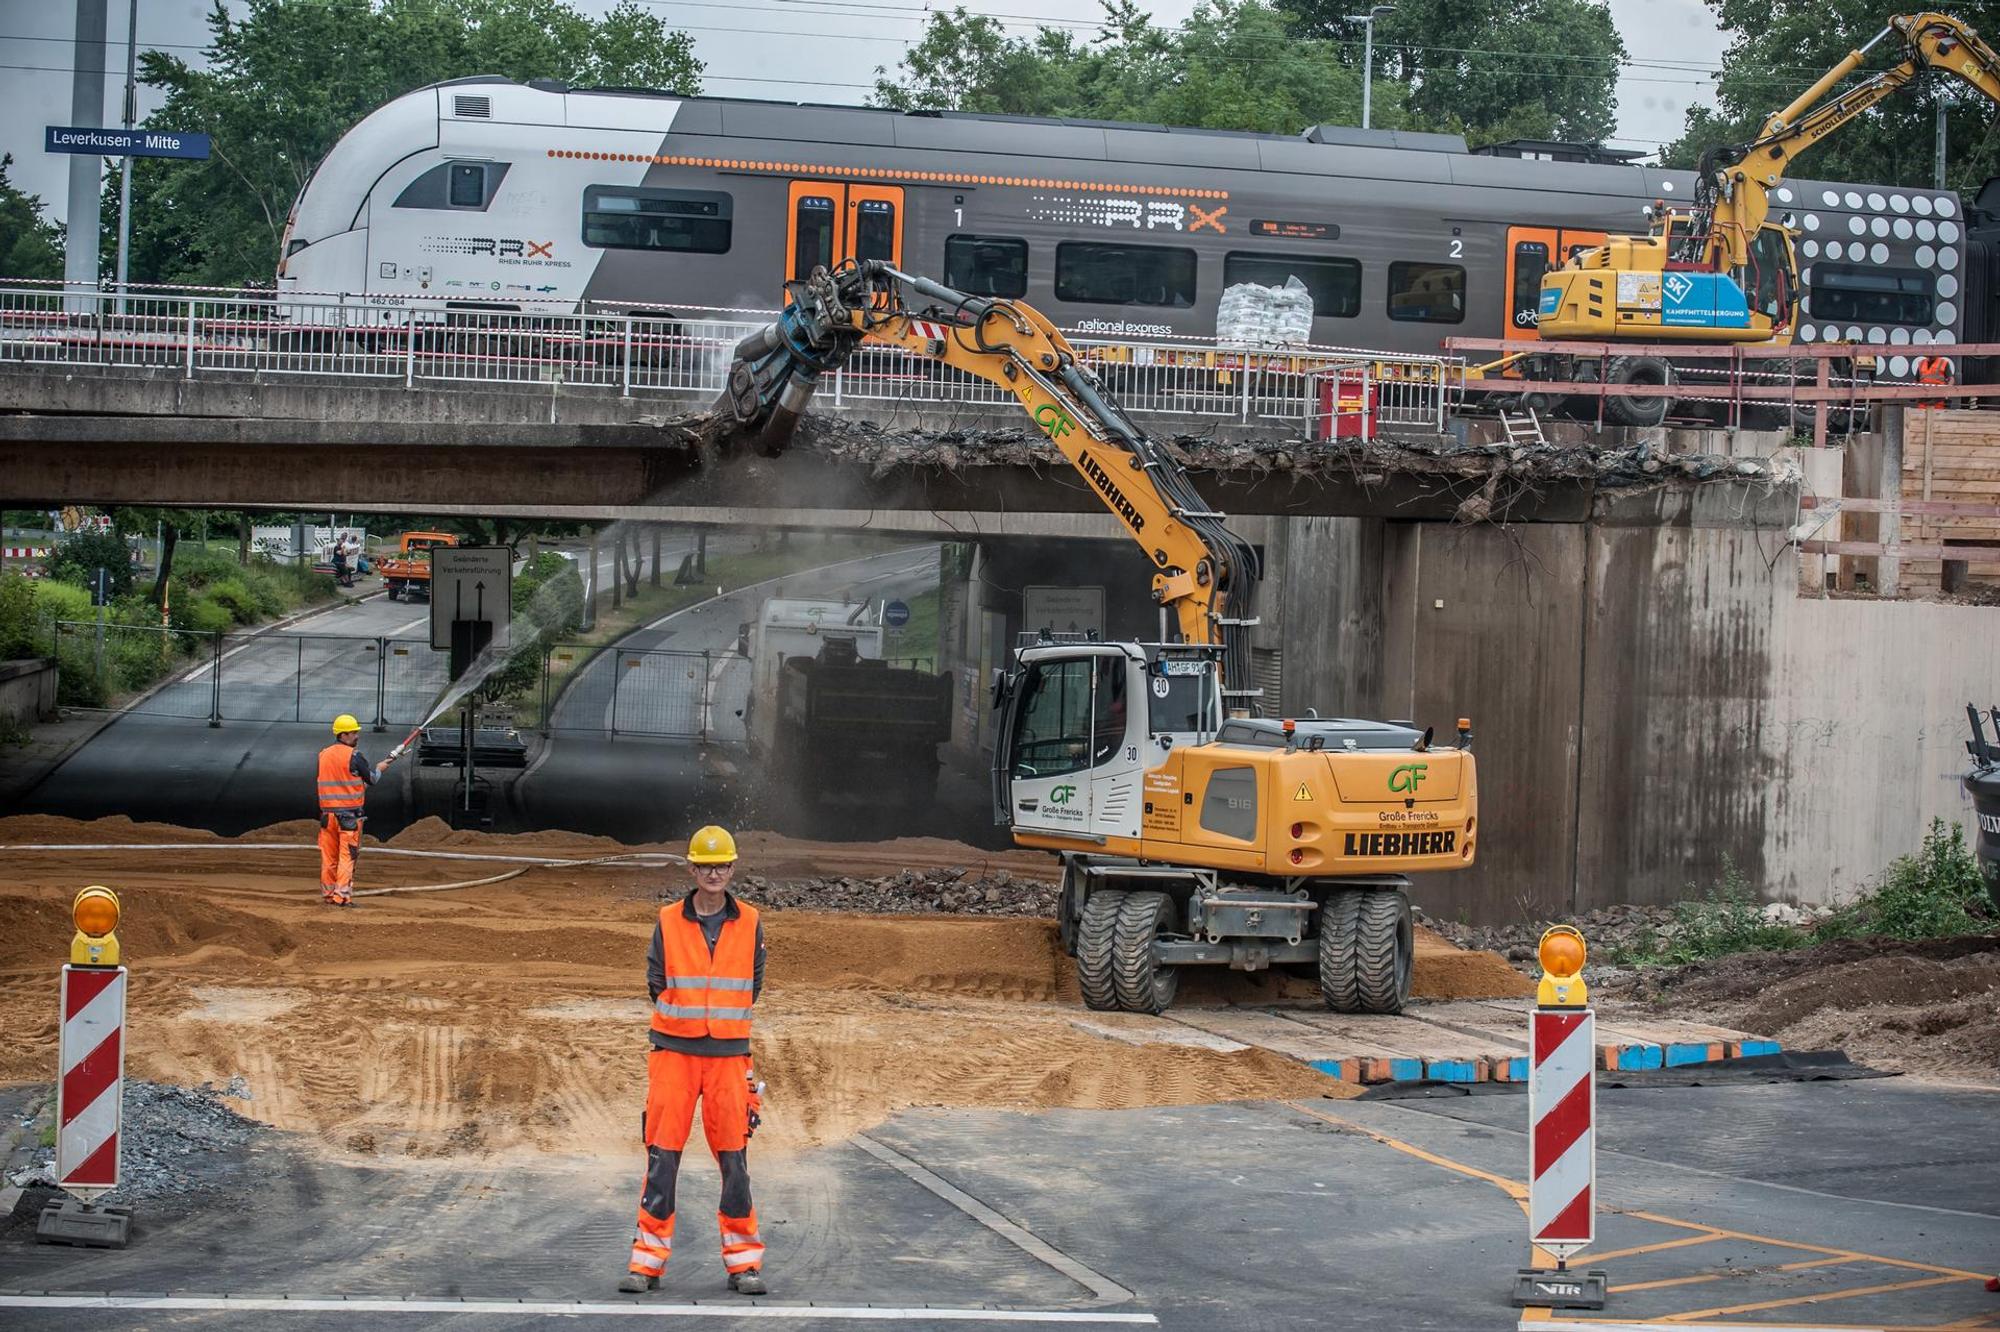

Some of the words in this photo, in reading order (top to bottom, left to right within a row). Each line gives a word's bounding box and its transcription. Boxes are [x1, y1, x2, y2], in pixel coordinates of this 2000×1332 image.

[53, 130, 131, 147] Leverkusen
[145, 135, 180, 150] Mitte
[954, 208, 963, 227] 1
[1449, 239, 1463, 258] 2
[523, 259, 543, 267] RUHR
[544, 260, 572, 268] XPRESS
[1665, 276, 1686, 296] SK
[1665, 308, 1745, 317] KAMPFMITTELBERGUNG
[1078, 318, 1125, 332] national
[1126, 322, 1172, 335] express
[1034, 403, 1076, 438] GF
[1077, 449, 1145, 535] LIEBHERR
[1156, 679, 1167, 693] 30
[1126, 747, 1137, 761] 30
[1387, 764, 1428, 794] GF
[1050, 784, 1077, 805] GF
[1042, 805, 1060, 814] Große
[1060, 807, 1083, 817] Frericks
[1378, 811, 1407, 821] Große
[1408, 811, 1439, 821] Frericks
[1343, 830, 1456, 856] LIEBHERR
